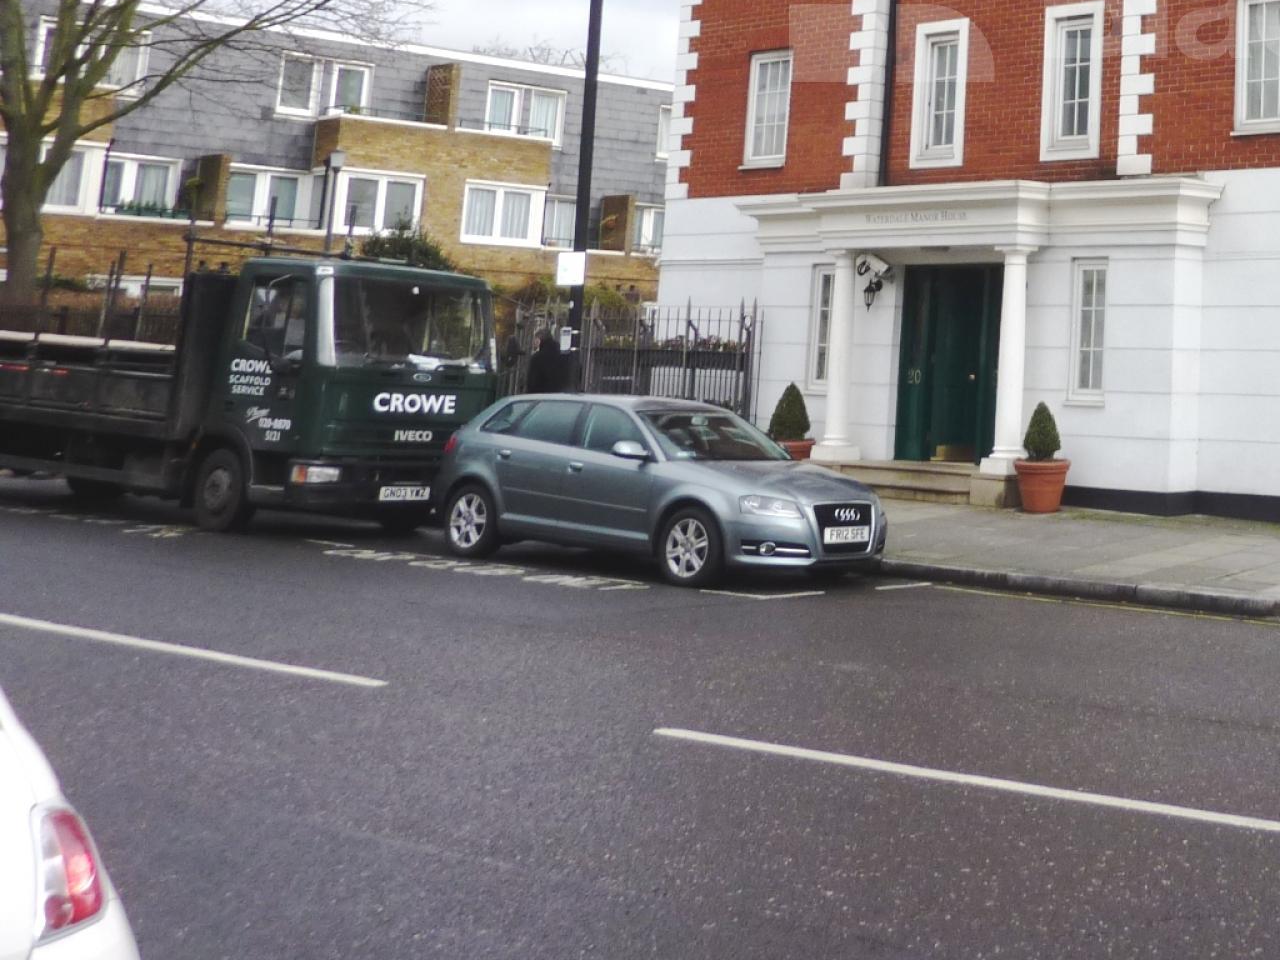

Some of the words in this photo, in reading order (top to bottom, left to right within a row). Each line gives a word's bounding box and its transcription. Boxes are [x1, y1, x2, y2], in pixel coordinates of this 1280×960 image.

[229, 374, 271, 386] SCAFFOLD
[231, 384, 265, 396] SERVICE
[373, 392, 457, 415] CROWE
[394, 430, 433, 442] IVECO
[830, 529, 849, 540] FR12
